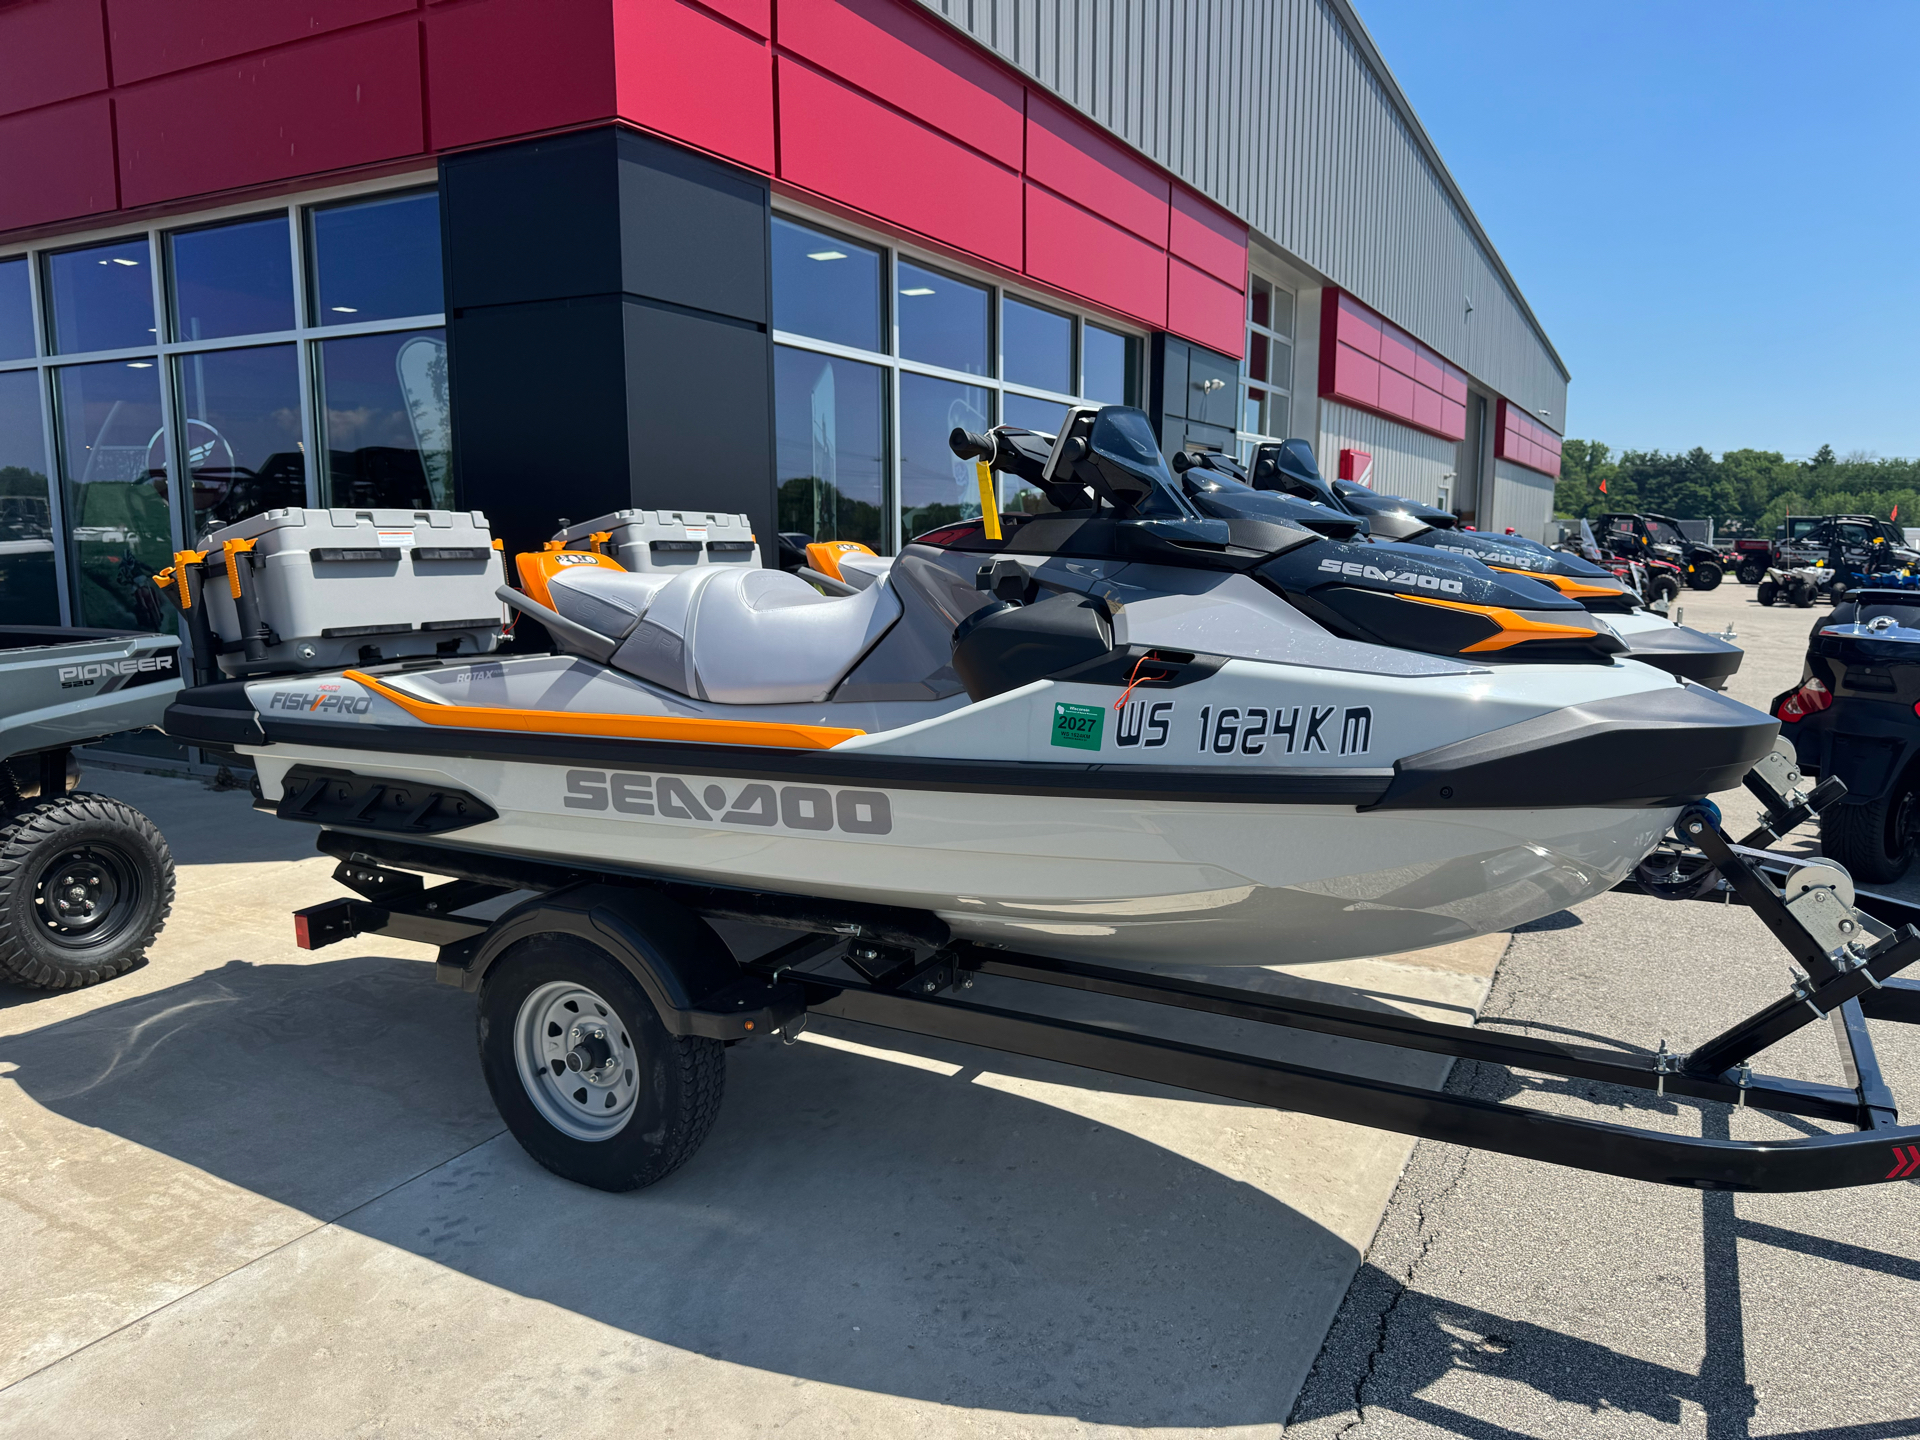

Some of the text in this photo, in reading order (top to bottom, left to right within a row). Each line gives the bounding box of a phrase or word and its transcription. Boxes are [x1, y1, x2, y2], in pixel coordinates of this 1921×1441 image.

[58, 655, 173, 682] PIONEER
[457, 670, 493, 683] ROTAX
[1058, 716, 1097, 732] 2027
[1115, 700, 1175, 749] WS
